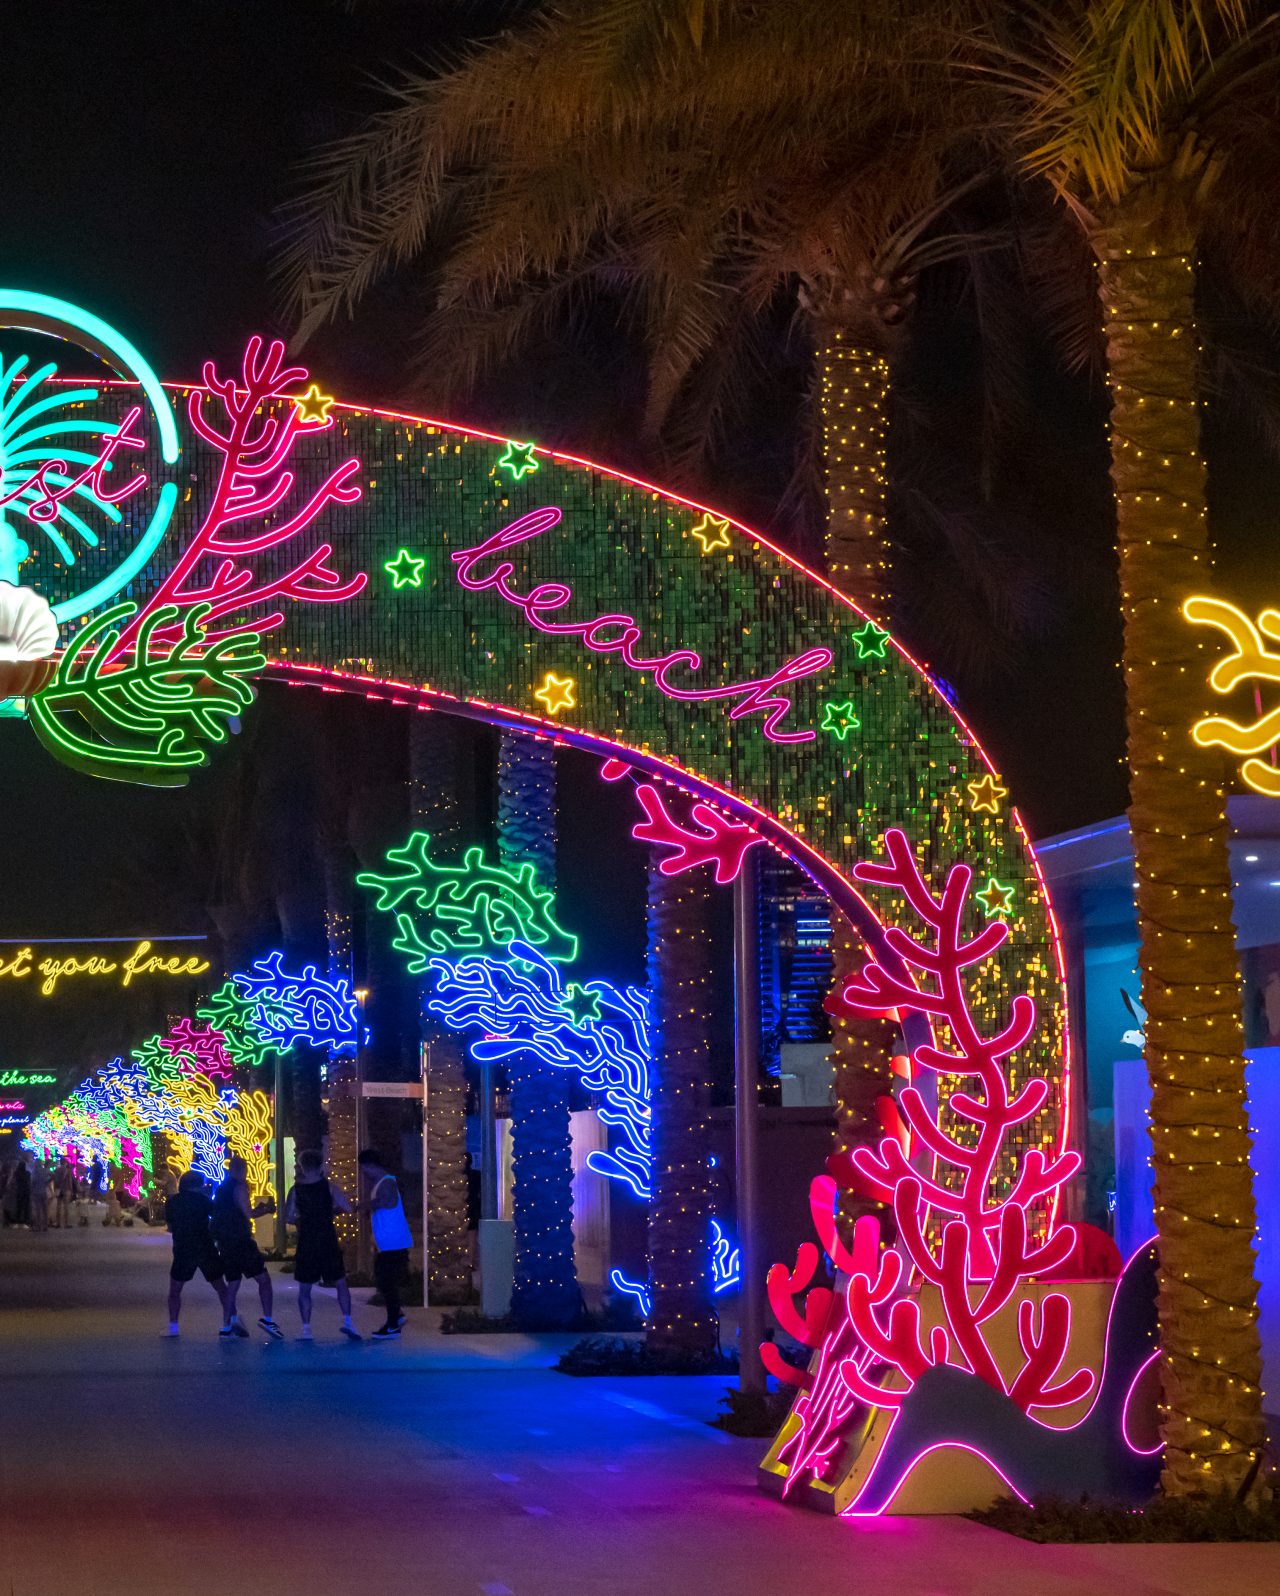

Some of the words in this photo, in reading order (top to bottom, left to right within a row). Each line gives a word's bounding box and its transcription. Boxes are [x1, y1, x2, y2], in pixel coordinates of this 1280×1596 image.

[451, 506, 833, 744] beach
[38, 956, 117, 996] you
[122, 940, 210, 987] free
[0, 1069, 29, 1086] the
[29, 1074, 57, 1085] sea
[1, 1115, 29, 1128] planet
